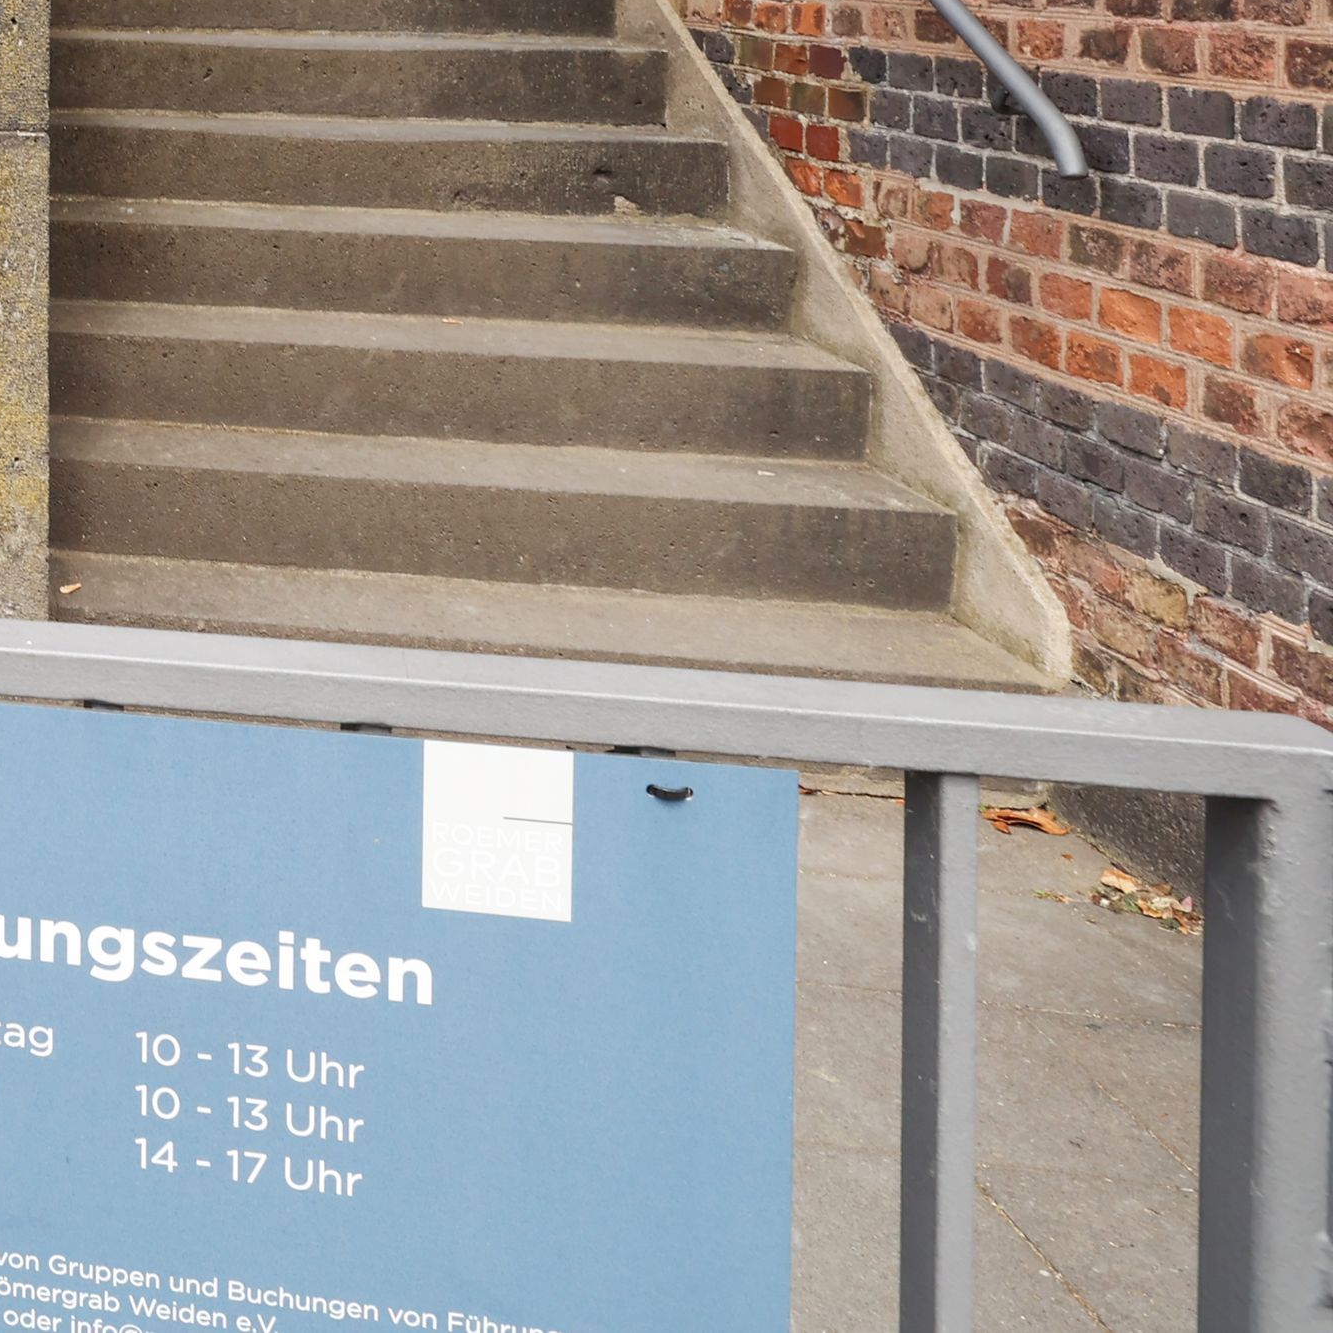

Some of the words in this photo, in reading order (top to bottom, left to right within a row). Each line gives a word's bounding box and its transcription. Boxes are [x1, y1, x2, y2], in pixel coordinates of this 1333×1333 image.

[135, 1031, 181, 1067] 10
[227, 1042, 269, 1078] 13
[286, 1048, 365, 1089] Uhr
[135, 1084, 181, 1120] 10
[227, 1096, 268, 1131] 13
[286, 1102, 365, 1143] Uhr
[134, 1137, 179, 1173] 14
[226, 1149, 268, 1184] 17
[284, 1156, 363, 1197] Uhr
[3, 1308, 62, 1332] oder
[48, 1254, 160, 1290] Gruppen
[169, 1275, 218, 1298] und
[228, 1280, 379, 1322] Buchungen
[388, 1307, 437, 1330] von
[128, 1294, 227, 1329] Weiden
[236, 1313, 279, 1333] e.V.
